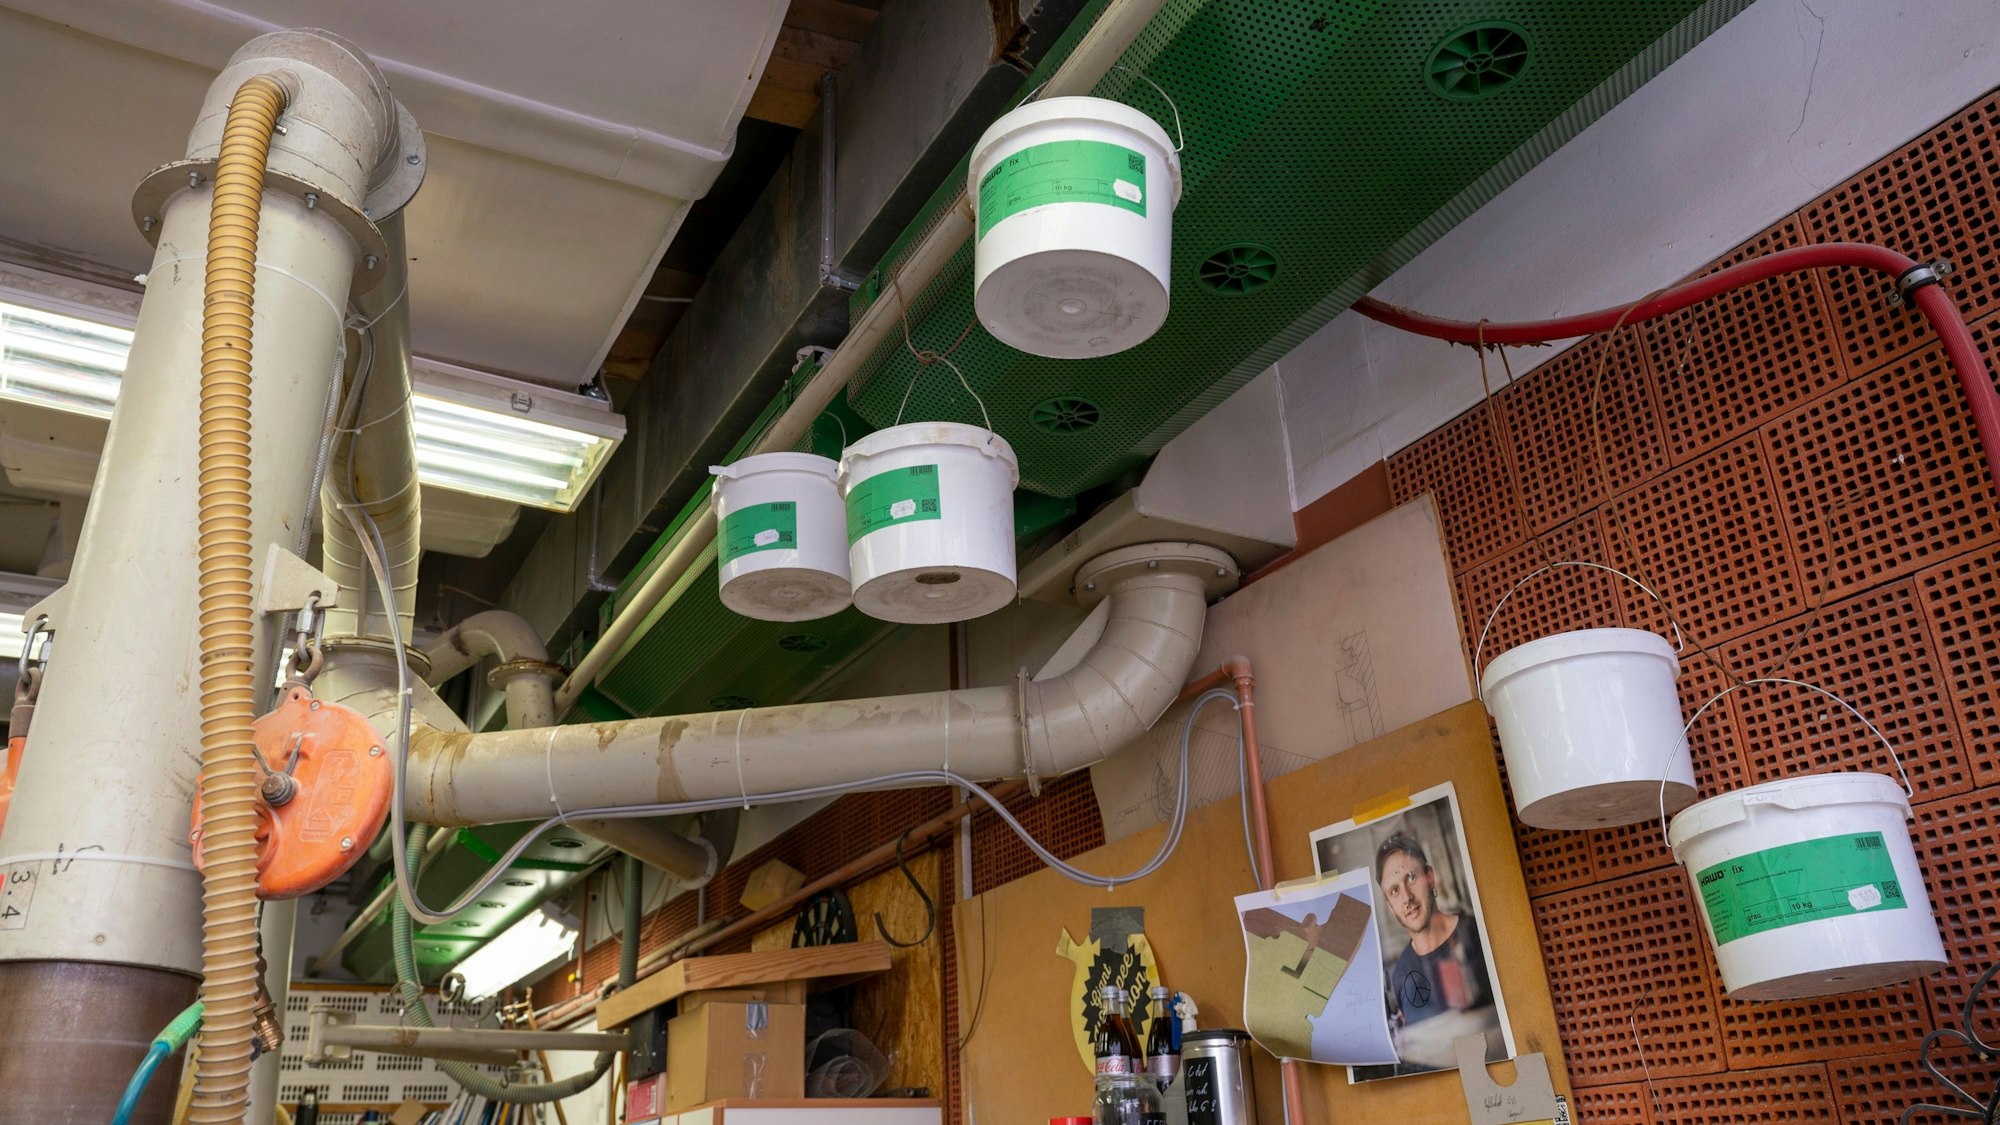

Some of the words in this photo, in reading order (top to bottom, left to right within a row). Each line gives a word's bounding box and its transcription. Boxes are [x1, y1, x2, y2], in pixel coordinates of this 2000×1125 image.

[1009, 158, 1019, 167] fix
[1731, 865, 1744, 875] fix
[1, 871, 31, 919] 3.4
[1803, 901, 1813, 909] kg
[1747, 913, 1762, 923] grau
[1090, 962, 1112, 1009] Giant
